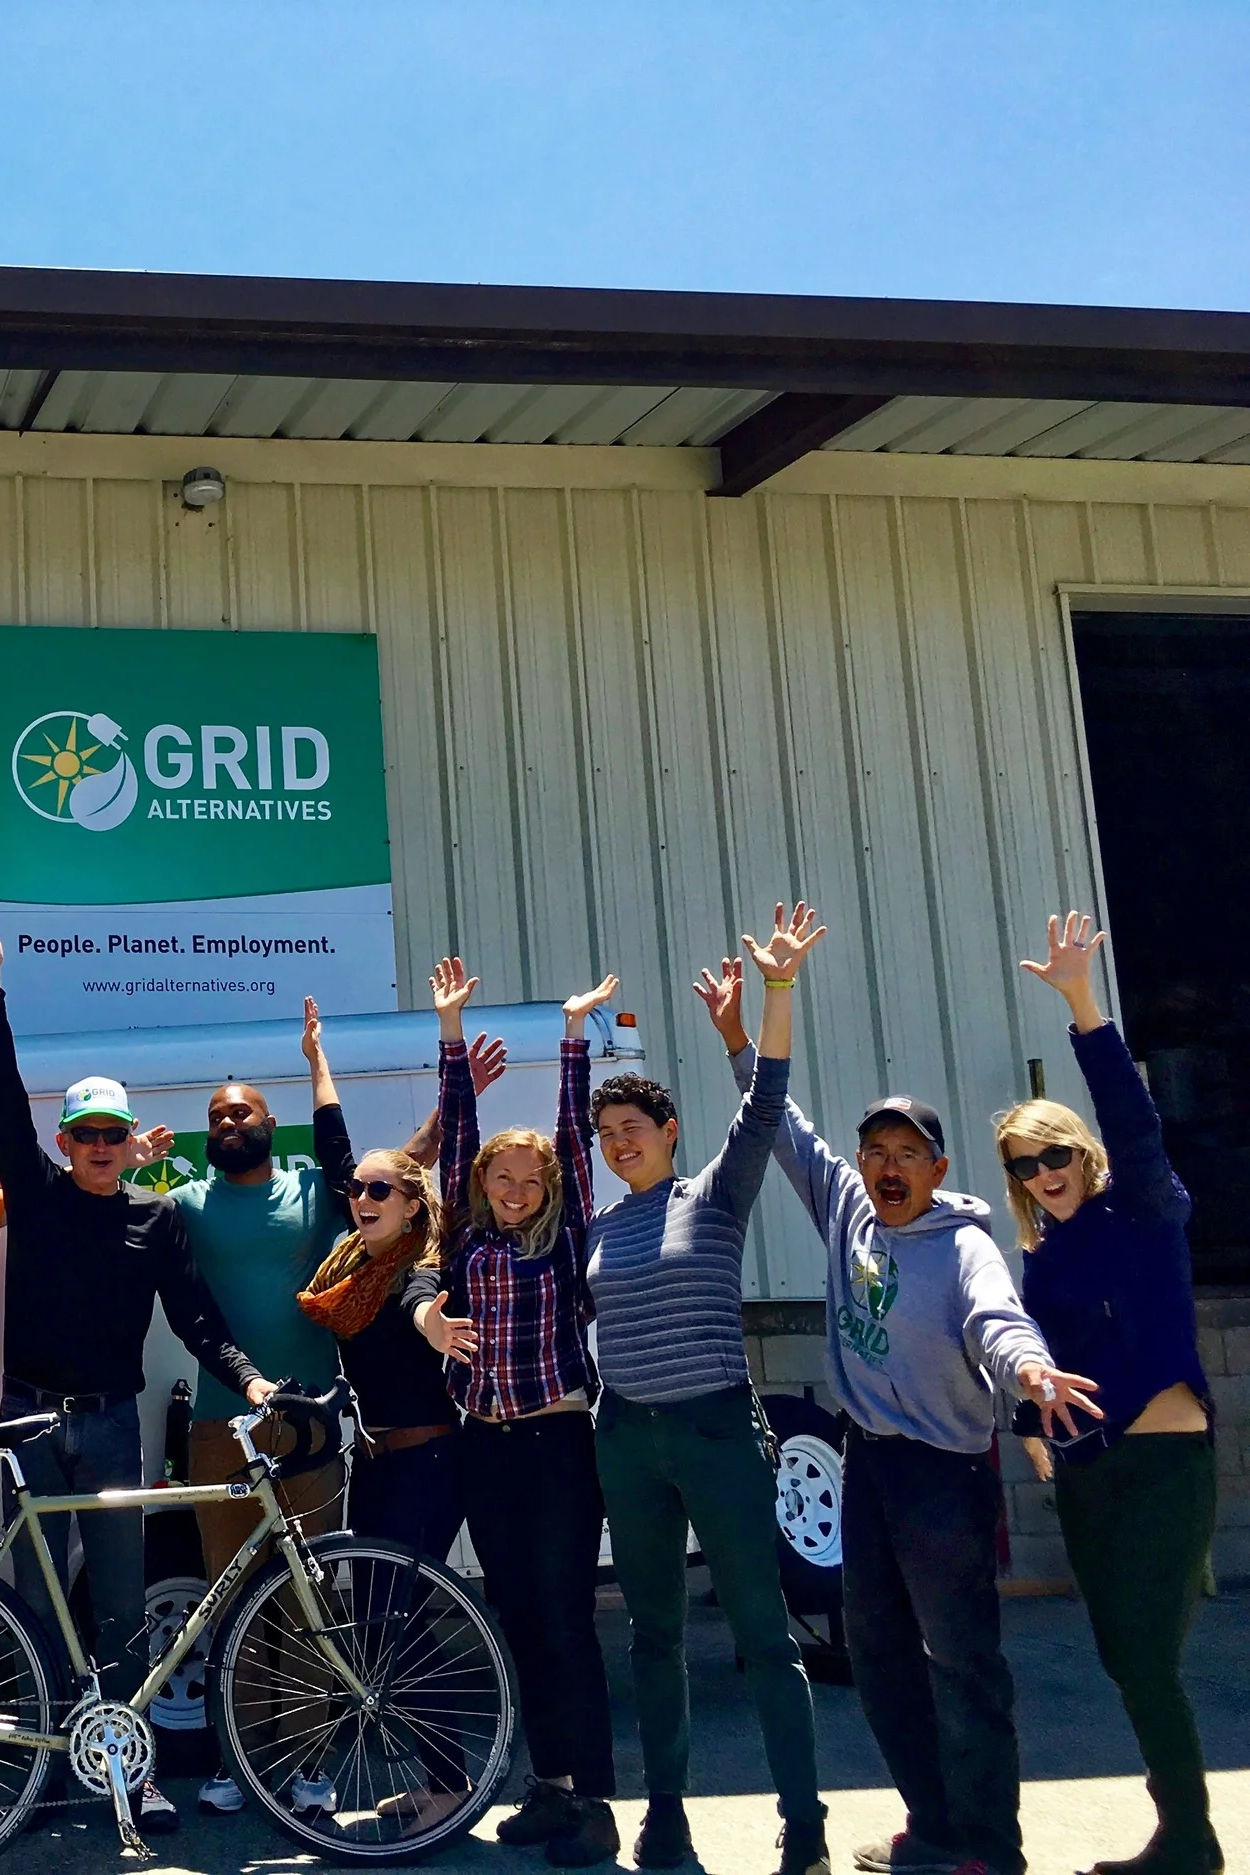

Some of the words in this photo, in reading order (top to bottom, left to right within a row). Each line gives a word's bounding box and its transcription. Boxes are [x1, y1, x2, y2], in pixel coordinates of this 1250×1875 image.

[144, 724, 330, 791] GRID
[147, 799, 332, 821] ALTERNATIVES
[18, 934, 101, 958] People.
[108, 934, 186, 954] Planet.
[192, 934, 336, 958] Employment.
[82, 977, 275, 996] www.gridalternatives.org
[91, 1088, 116, 1098] GRID
[198, 1558, 243, 1621] SURLY
